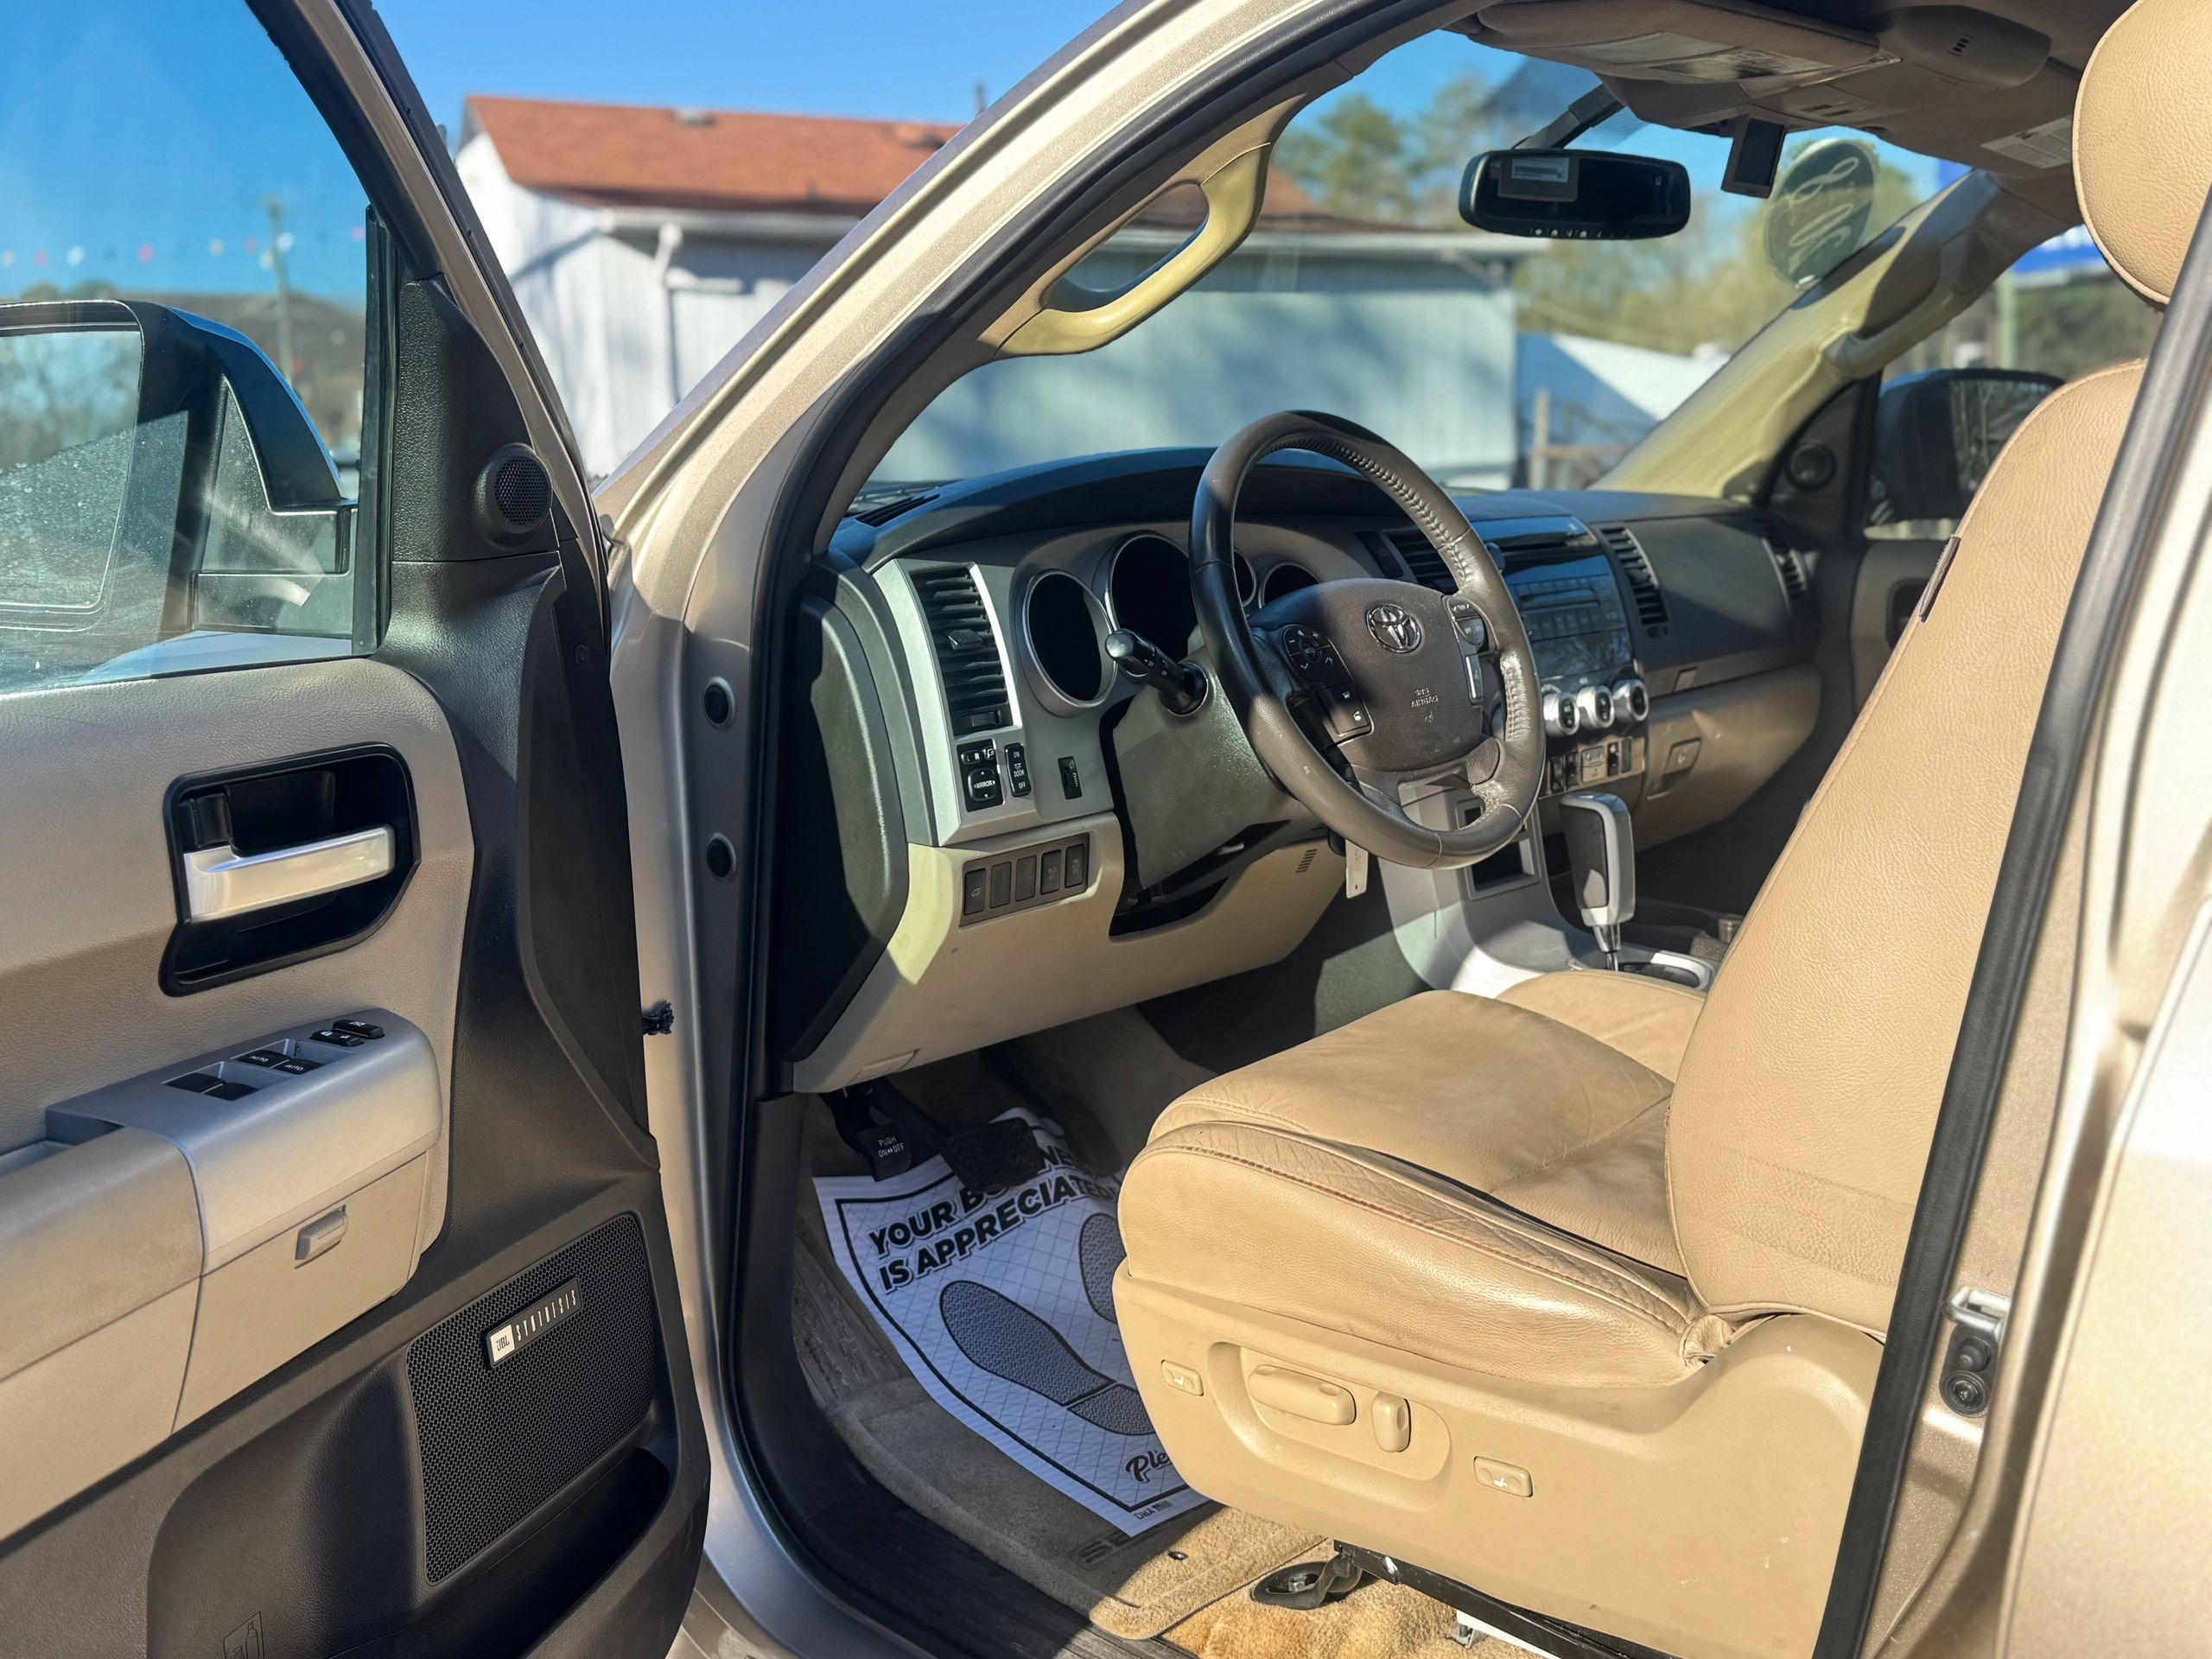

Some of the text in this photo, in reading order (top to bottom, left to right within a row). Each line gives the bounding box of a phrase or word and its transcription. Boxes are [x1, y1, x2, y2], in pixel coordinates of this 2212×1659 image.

[1411, 695, 1439, 708] AIRBAG
[878, 1135, 897, 1147] PUSH
[869, 1205, 956, 1256] YOUR
[879, 1258, 911, 1293] IS
[495, 1335, 511, 1352] JBL
[1125, 1451, 1170, 1482] Ple
